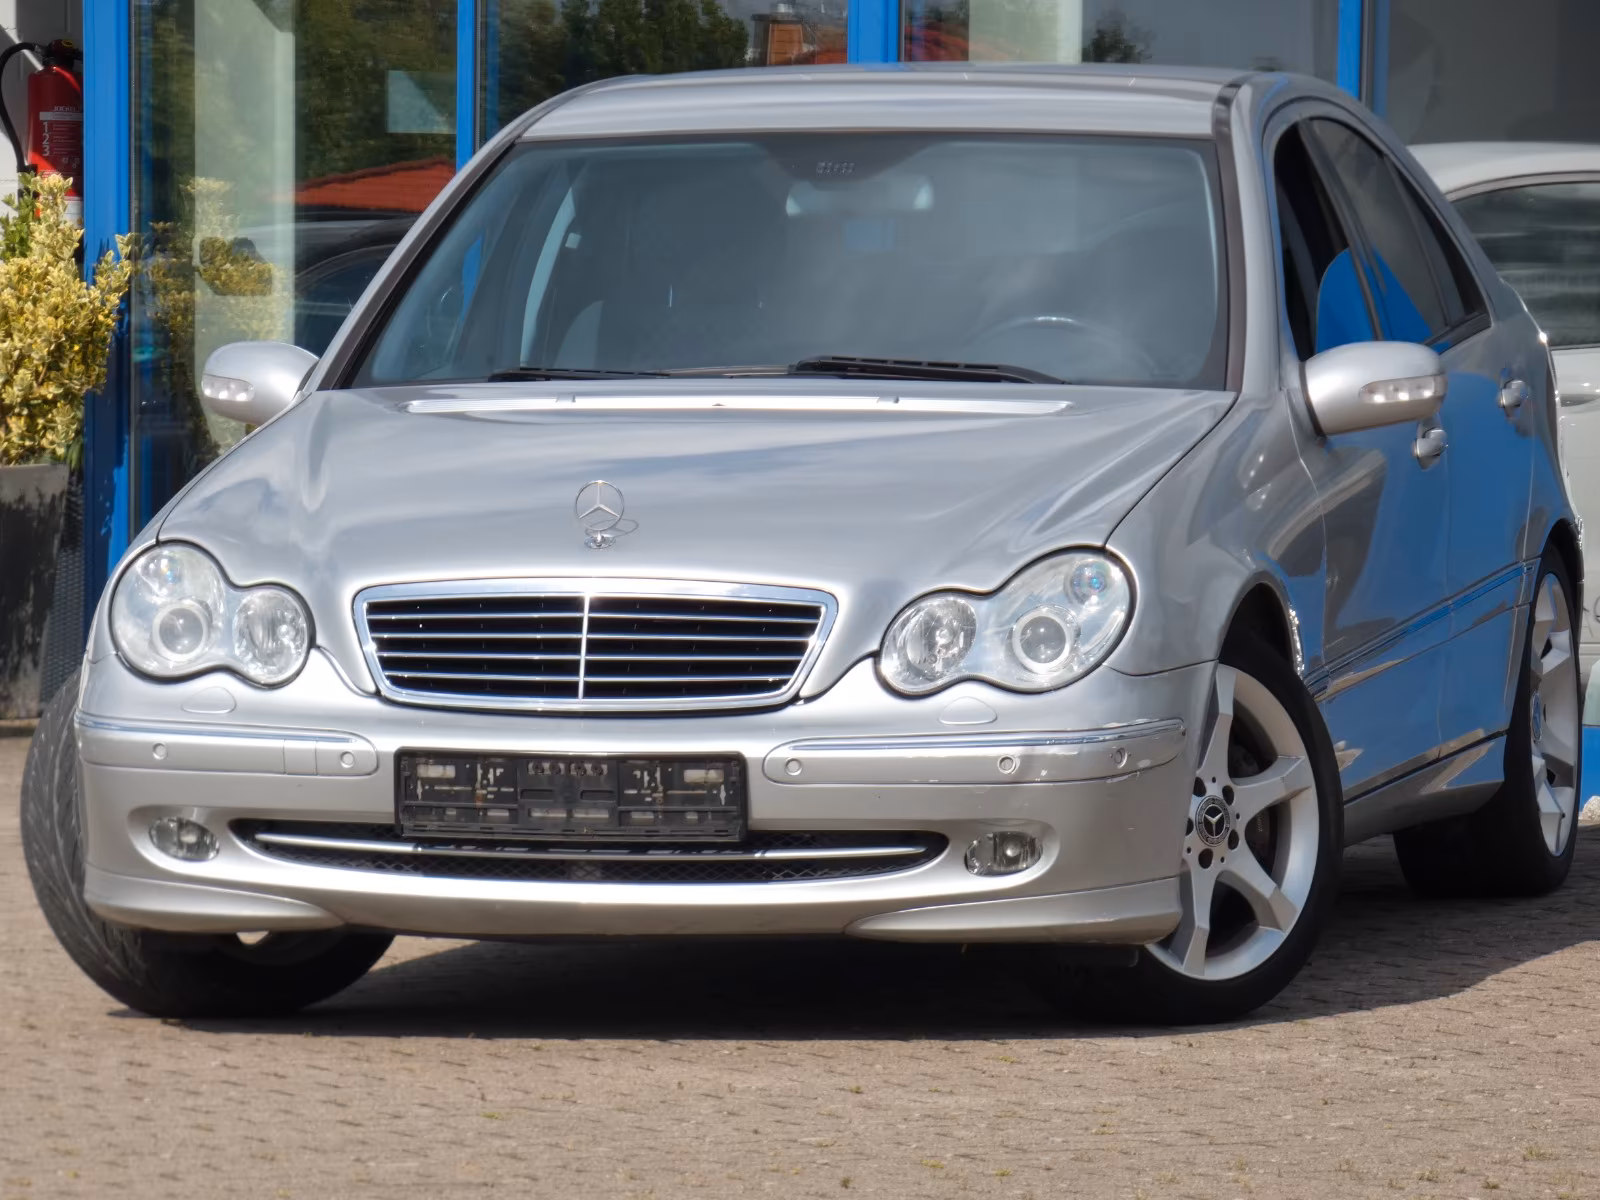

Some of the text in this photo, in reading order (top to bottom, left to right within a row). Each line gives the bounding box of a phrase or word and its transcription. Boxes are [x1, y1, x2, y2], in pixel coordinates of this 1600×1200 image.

[42, 121, 48, 133] 1
[43, 133, 49, 144] 2
[43, 145, 49, 156] 3
